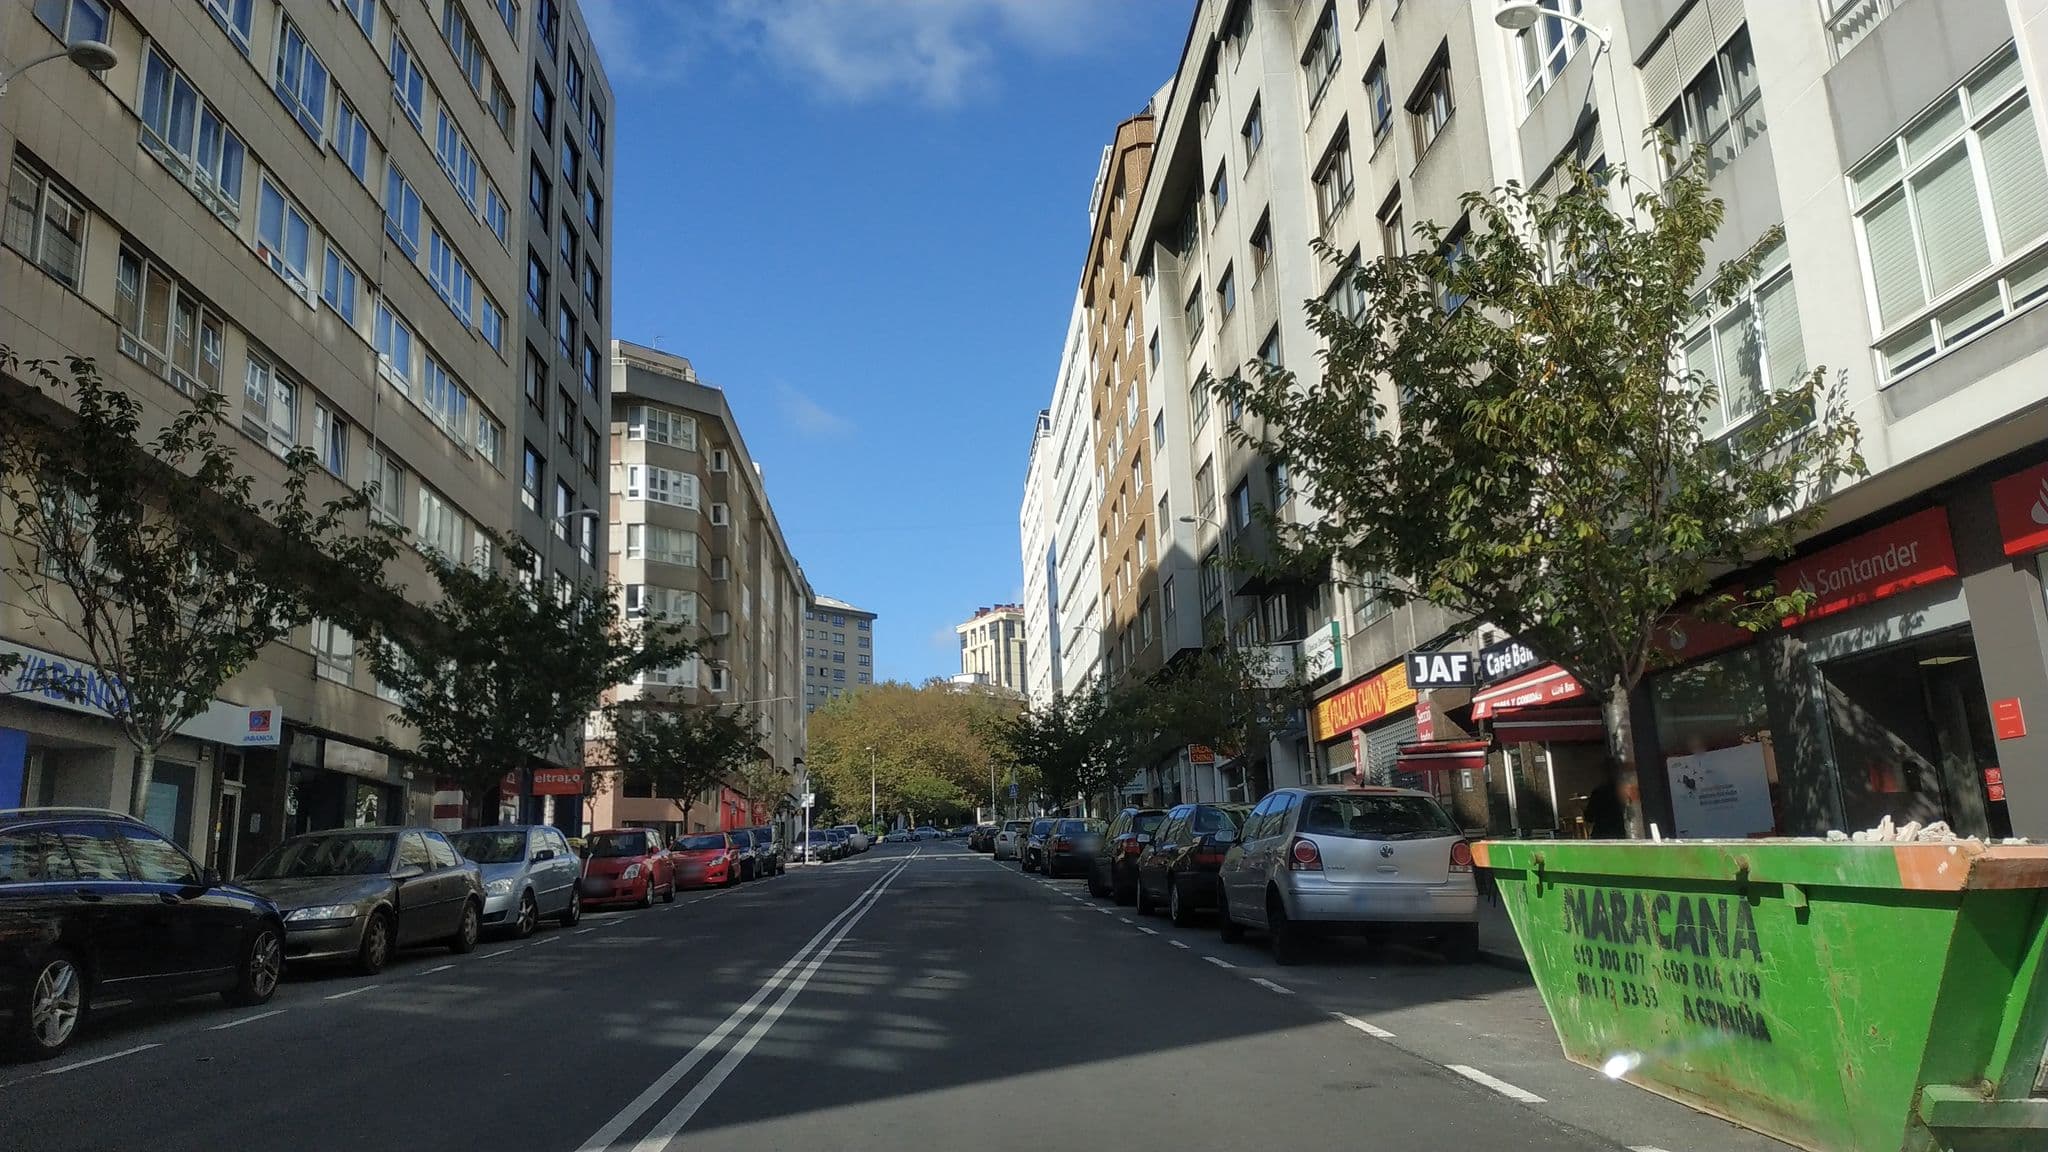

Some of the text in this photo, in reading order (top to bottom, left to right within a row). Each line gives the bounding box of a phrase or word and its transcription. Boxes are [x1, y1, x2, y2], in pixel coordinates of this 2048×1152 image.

[1816, 541, 1918, 596] Santander
[1414, 654, 1468, 683] JAF
[1487, 646, 1511, 676] Café
[1332, 691, 1359, 730] BAZAR
[1357, 679, 1384, 719] CHINO
[1563, 887, 1764, 964] MARACANA
[1573, 943, 1594, 968] 619
[1597, 946, 1621, 973] 300
[1663, 958, 1689, 987] 609
[1621, 980, 1640, 1006] 33
[1642, 984, 1659, 1009] 33
